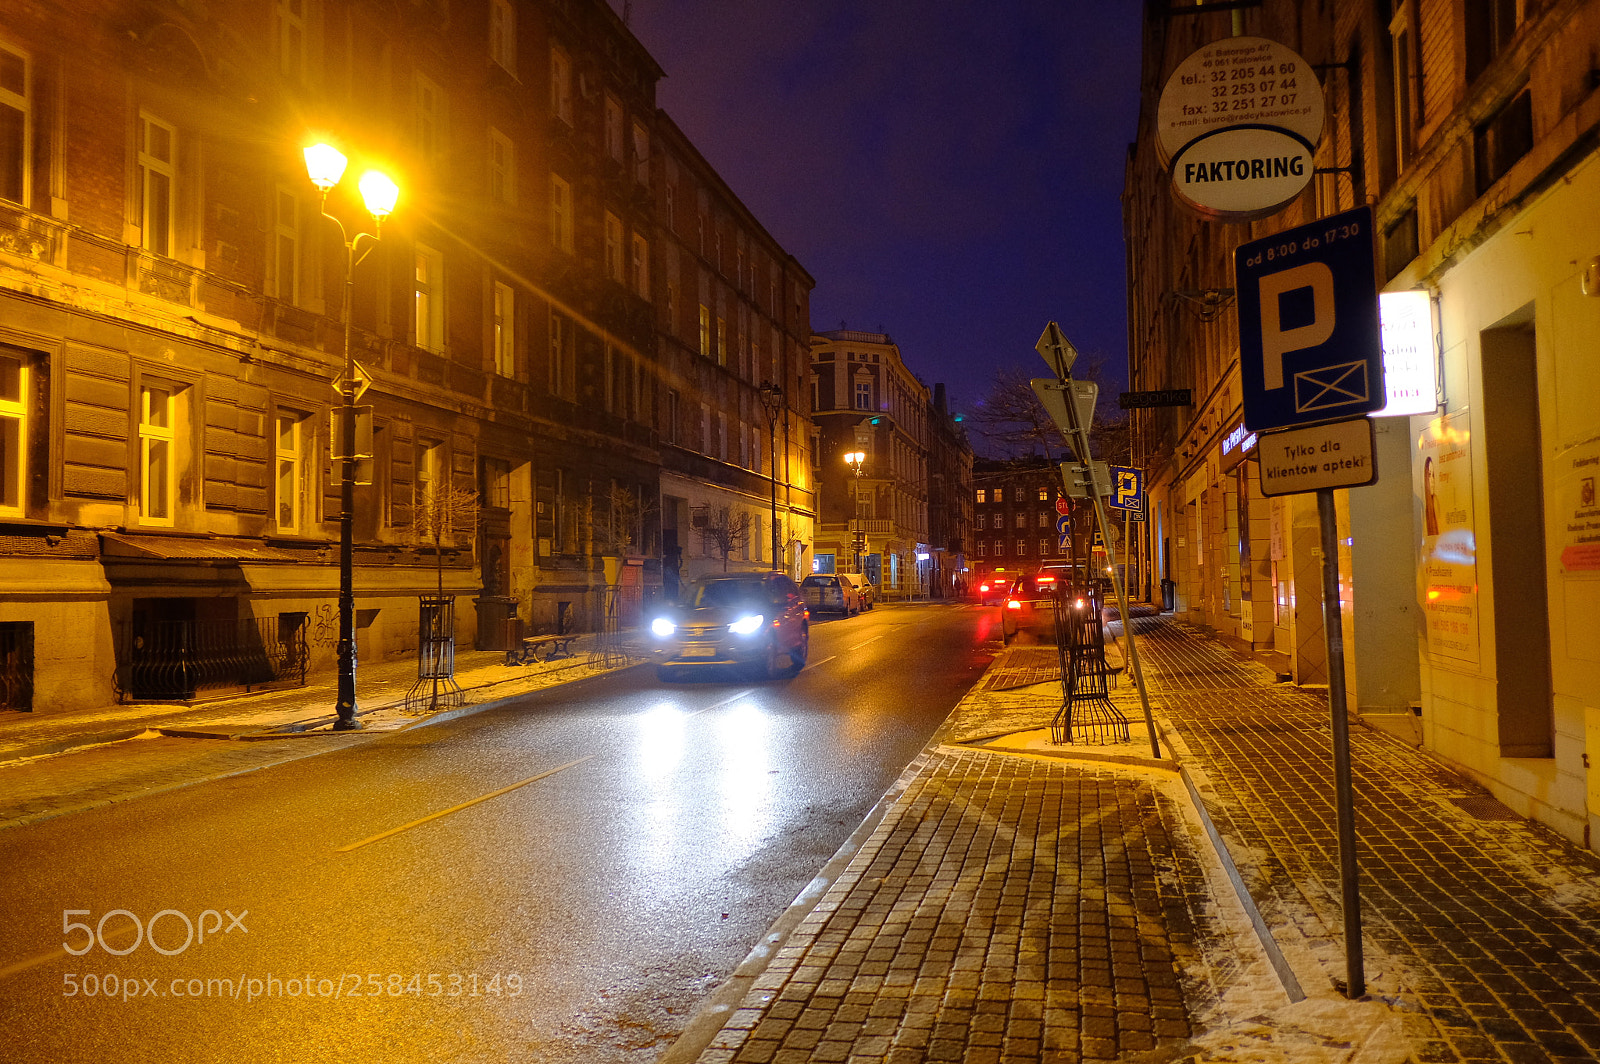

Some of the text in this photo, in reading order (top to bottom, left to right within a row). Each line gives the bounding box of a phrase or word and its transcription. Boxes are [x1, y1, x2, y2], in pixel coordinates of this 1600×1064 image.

[1232, 54, 1272, 65] Katowice
[1181, 62, 1296, 85] tel.: 32 205 44 60
[1212, 78, 1296, 98] 32 253 07 44
[1182, 94, 1297, 116] fax: 32 251 27 07
[1185, 156, 1303, 183] FAKTORING
[1246, 223, 1359, 267] od 8:00 do 17:30
[1258, 261, 1336, 391] P
[1284, 441, 1340, 460] Tylko dla
[1267, 456, 1364, 479] klientów apteki
[1117, 471, 1137, 504] P
